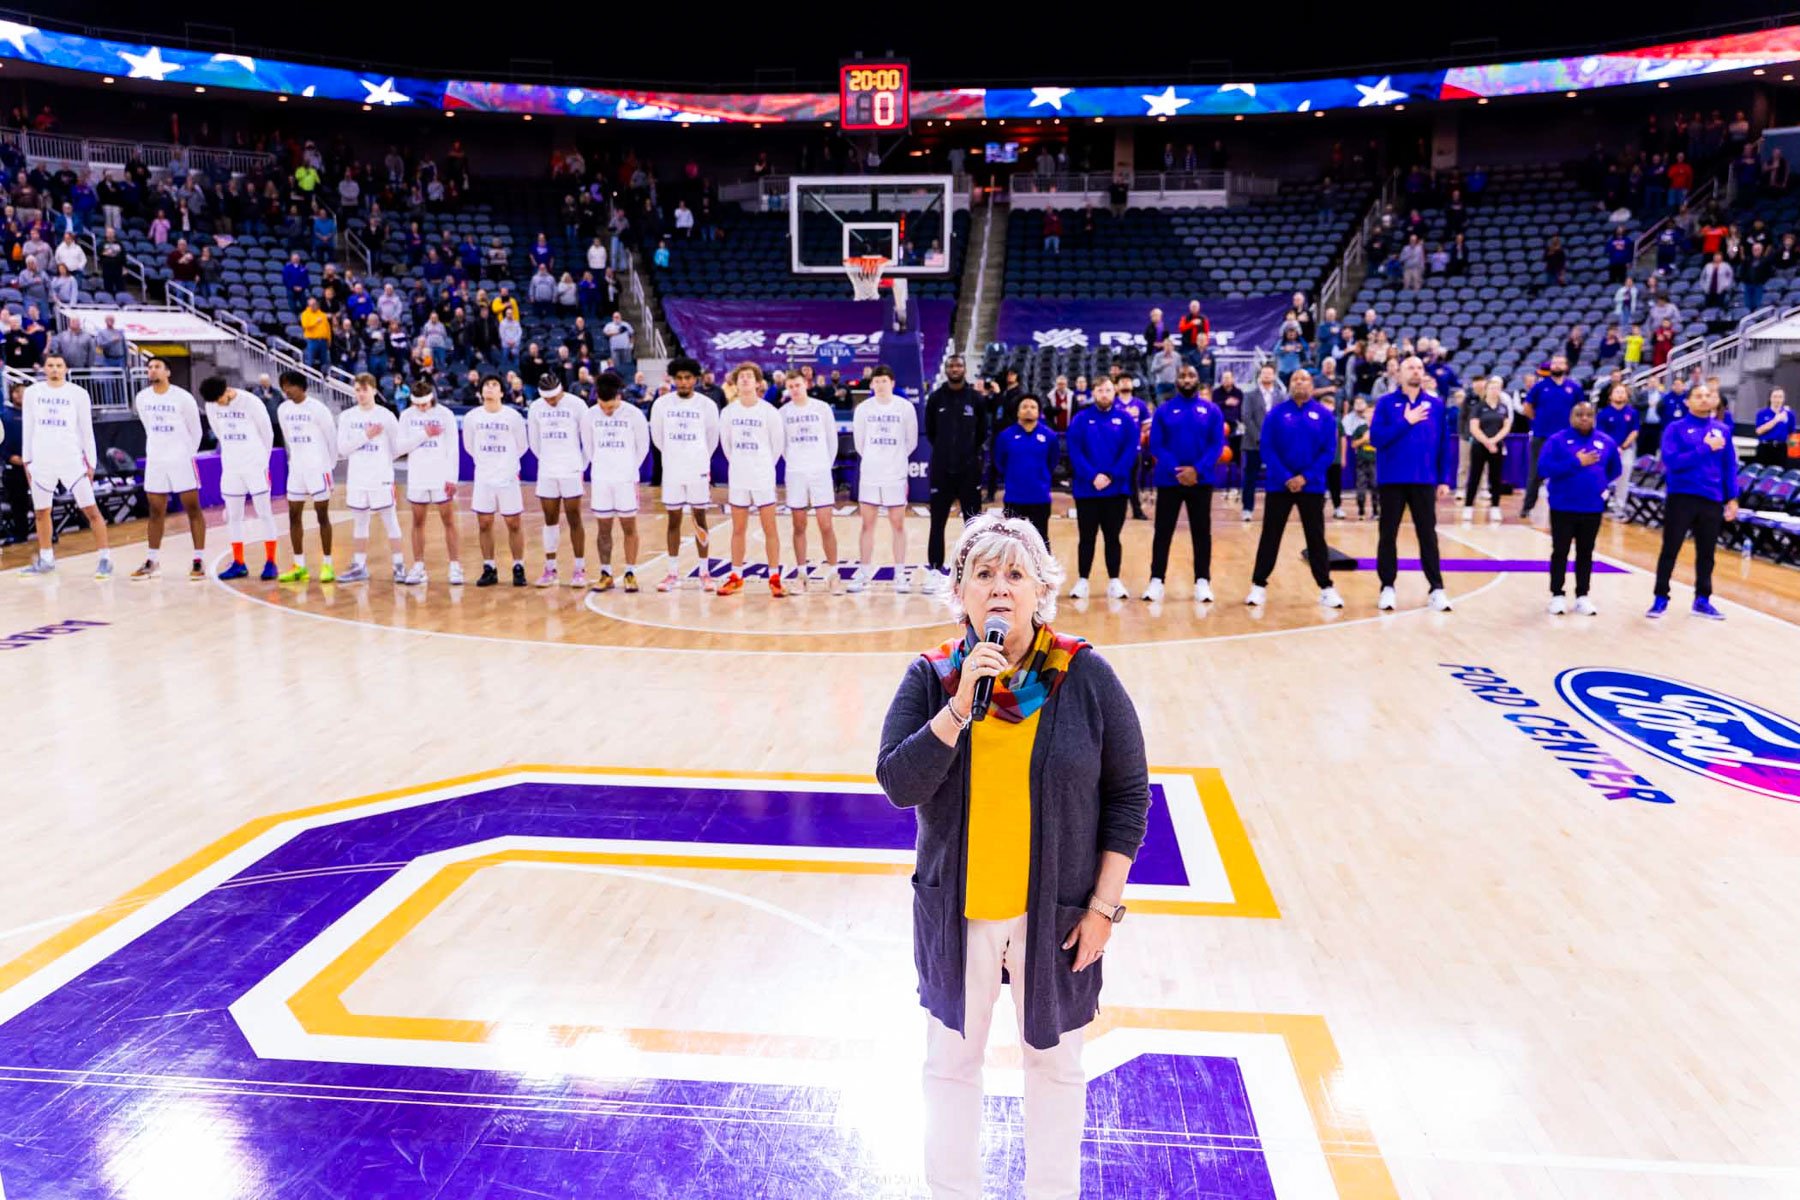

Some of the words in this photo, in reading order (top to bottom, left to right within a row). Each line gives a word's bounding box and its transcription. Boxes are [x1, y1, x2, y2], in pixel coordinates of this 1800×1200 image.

[849, 69, 900, 91] 20:00
[874, 91, 895, 126] 0
[776, 331, 884, 345] Ruof
[1438, 663, 1540, 707] FORD
[1503, 713, 1676, 804] CENTER
[1586, 686, 1800, 771] Ford
